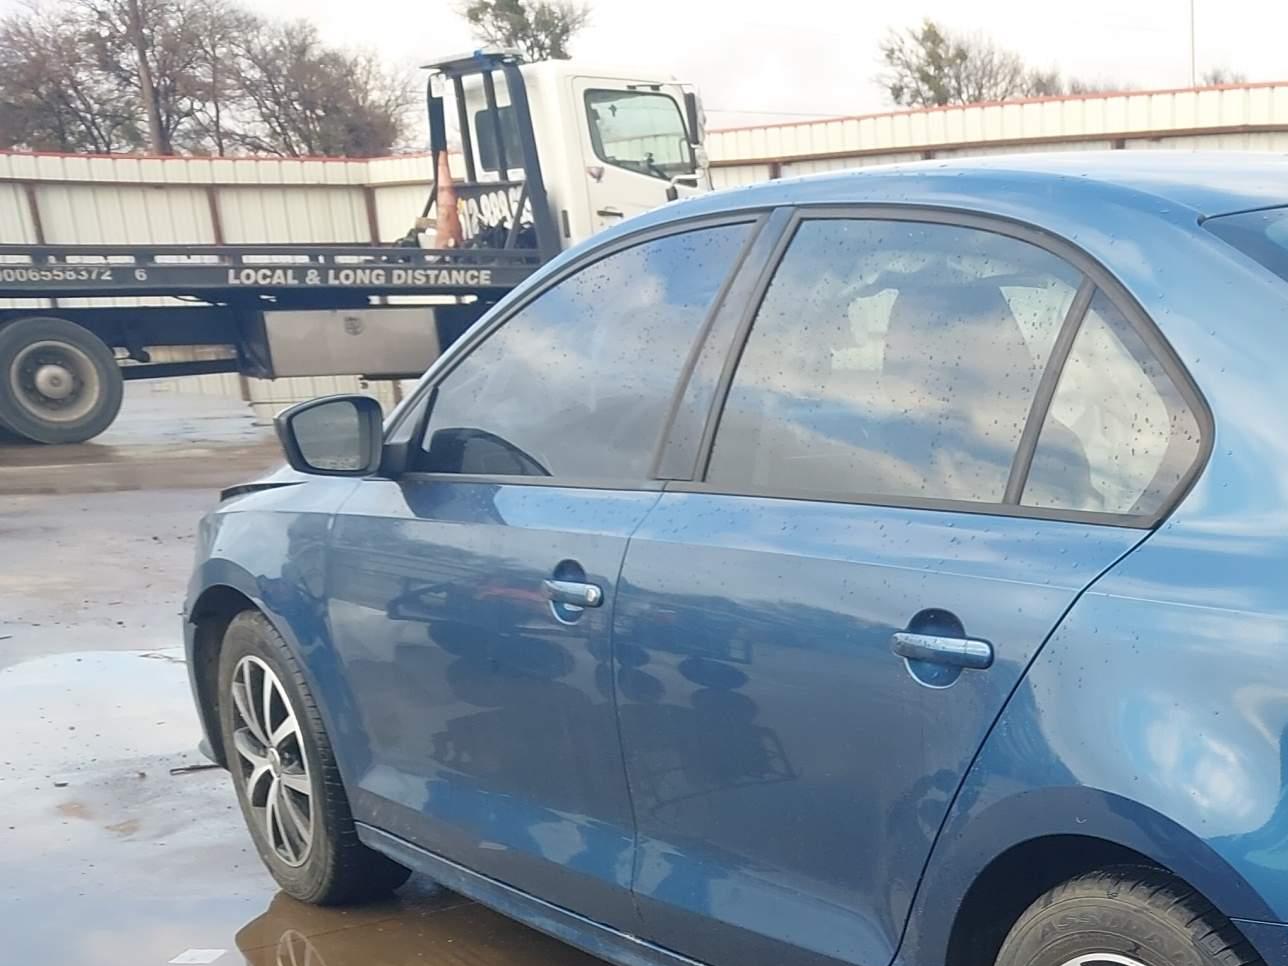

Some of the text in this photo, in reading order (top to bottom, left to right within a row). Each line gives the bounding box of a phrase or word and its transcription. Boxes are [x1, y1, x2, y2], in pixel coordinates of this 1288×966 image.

[134, 268, 148, 281] 6
[228, 269, 492, 285] LOCAL & LONG DISTANCE
